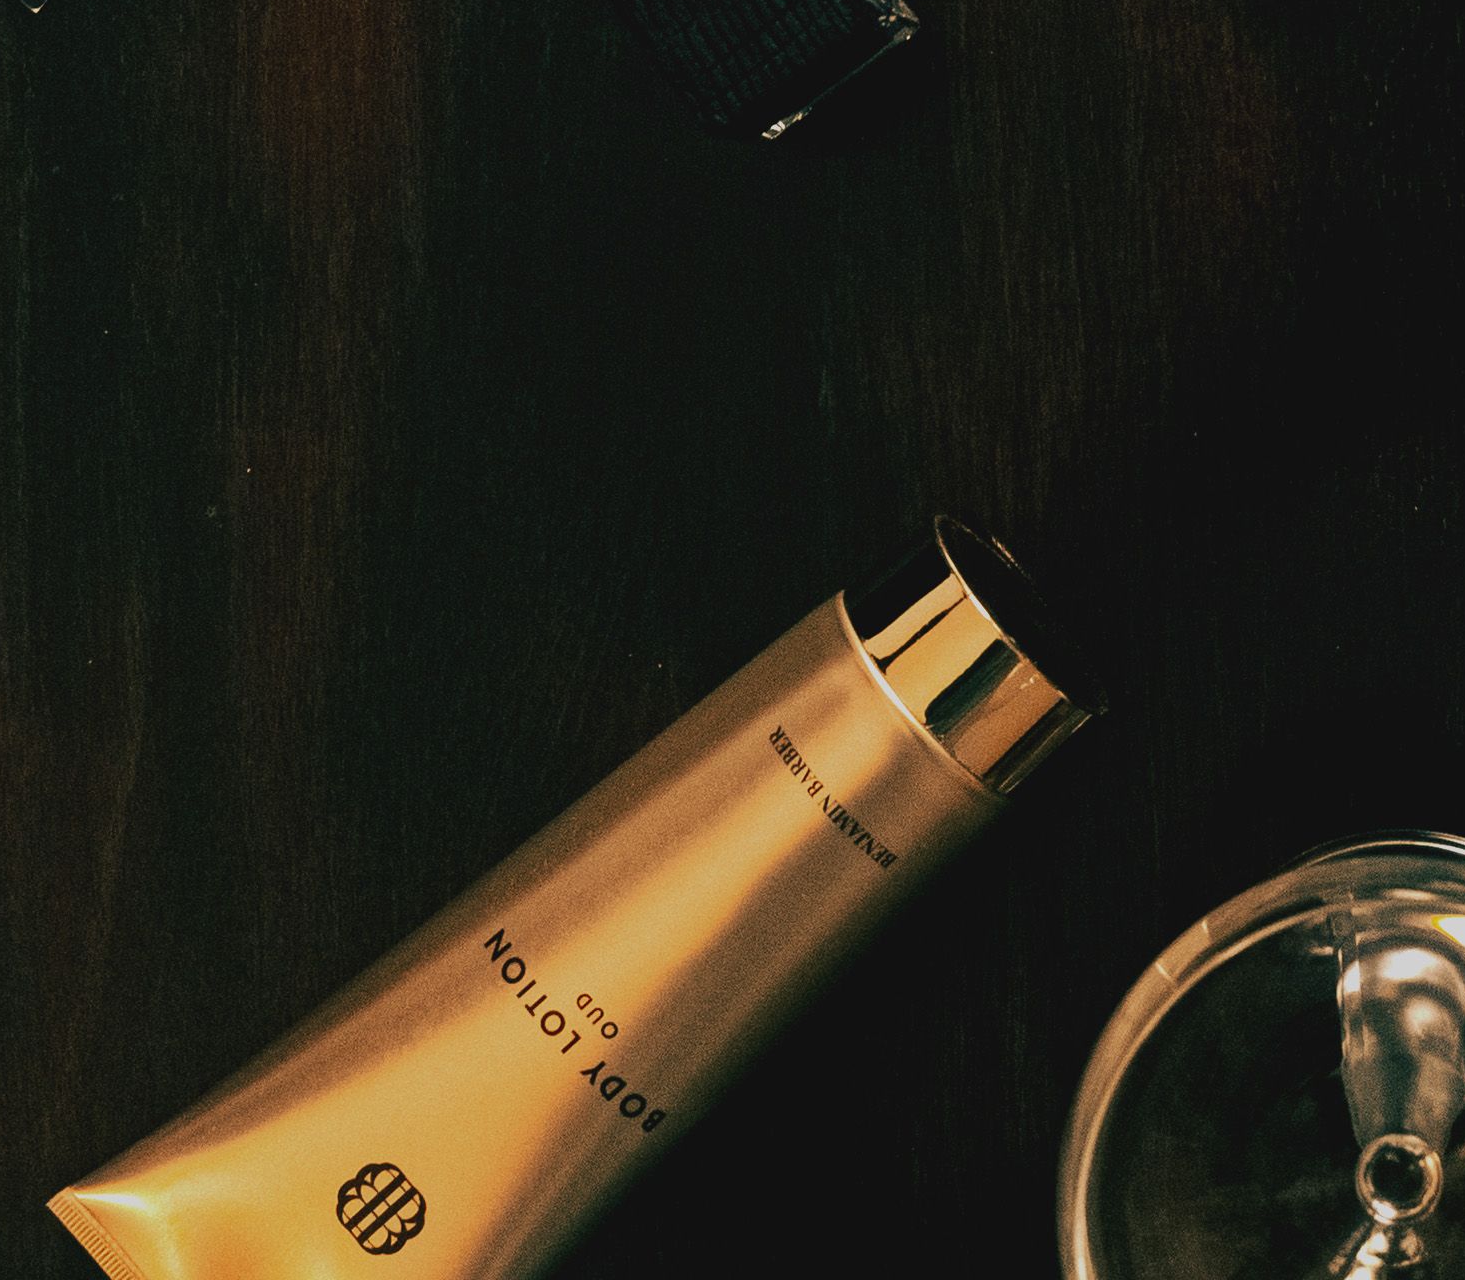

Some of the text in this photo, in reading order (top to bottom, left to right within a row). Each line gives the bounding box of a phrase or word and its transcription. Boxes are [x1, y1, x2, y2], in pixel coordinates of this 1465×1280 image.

[768, 724, 899, 870] BENJAMIN BARBER
[483, 927, 668, 1134] BODY LOTION
[576, 993, 619, 1040] OUD
